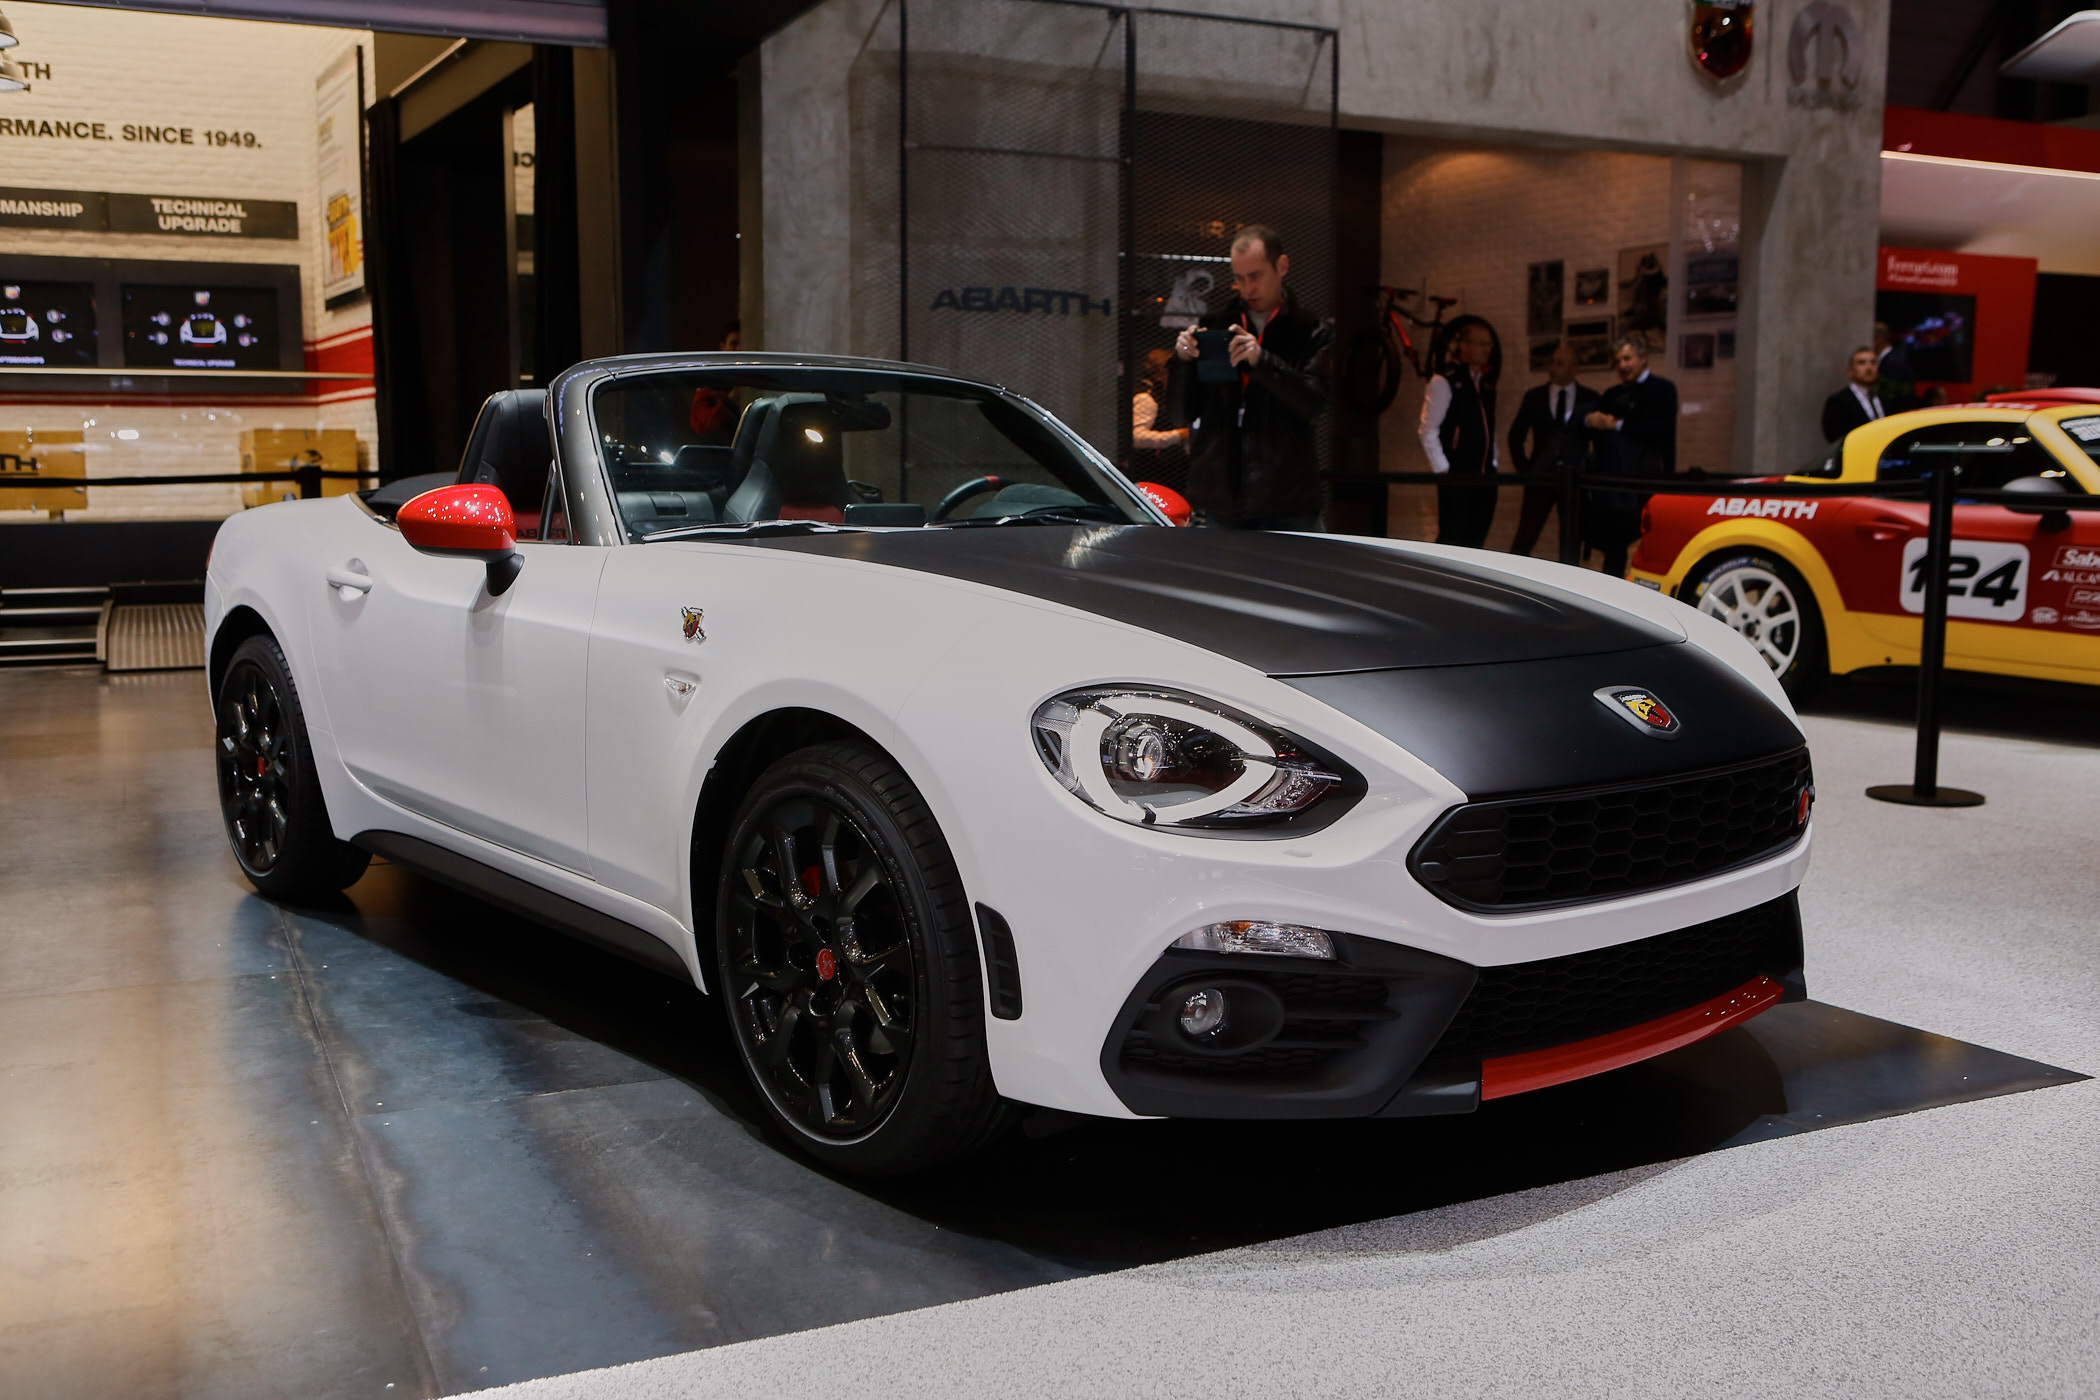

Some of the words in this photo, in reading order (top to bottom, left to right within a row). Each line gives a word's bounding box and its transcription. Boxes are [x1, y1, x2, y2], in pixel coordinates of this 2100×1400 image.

[0, 118, 114, 140] RMANCE.
[122, 123, 194, 145] SINCE
[203, 130, 262, 149] 1949.
[0, 199, 83, 217] MANSHIP
[150, 198, 247, 218] TECHNICAL
[158, 214, 241, 234] UPGRADE
[930, 286, 1111, 316] ABARTH
[1707, 497, 1819, 520] ABARTH
